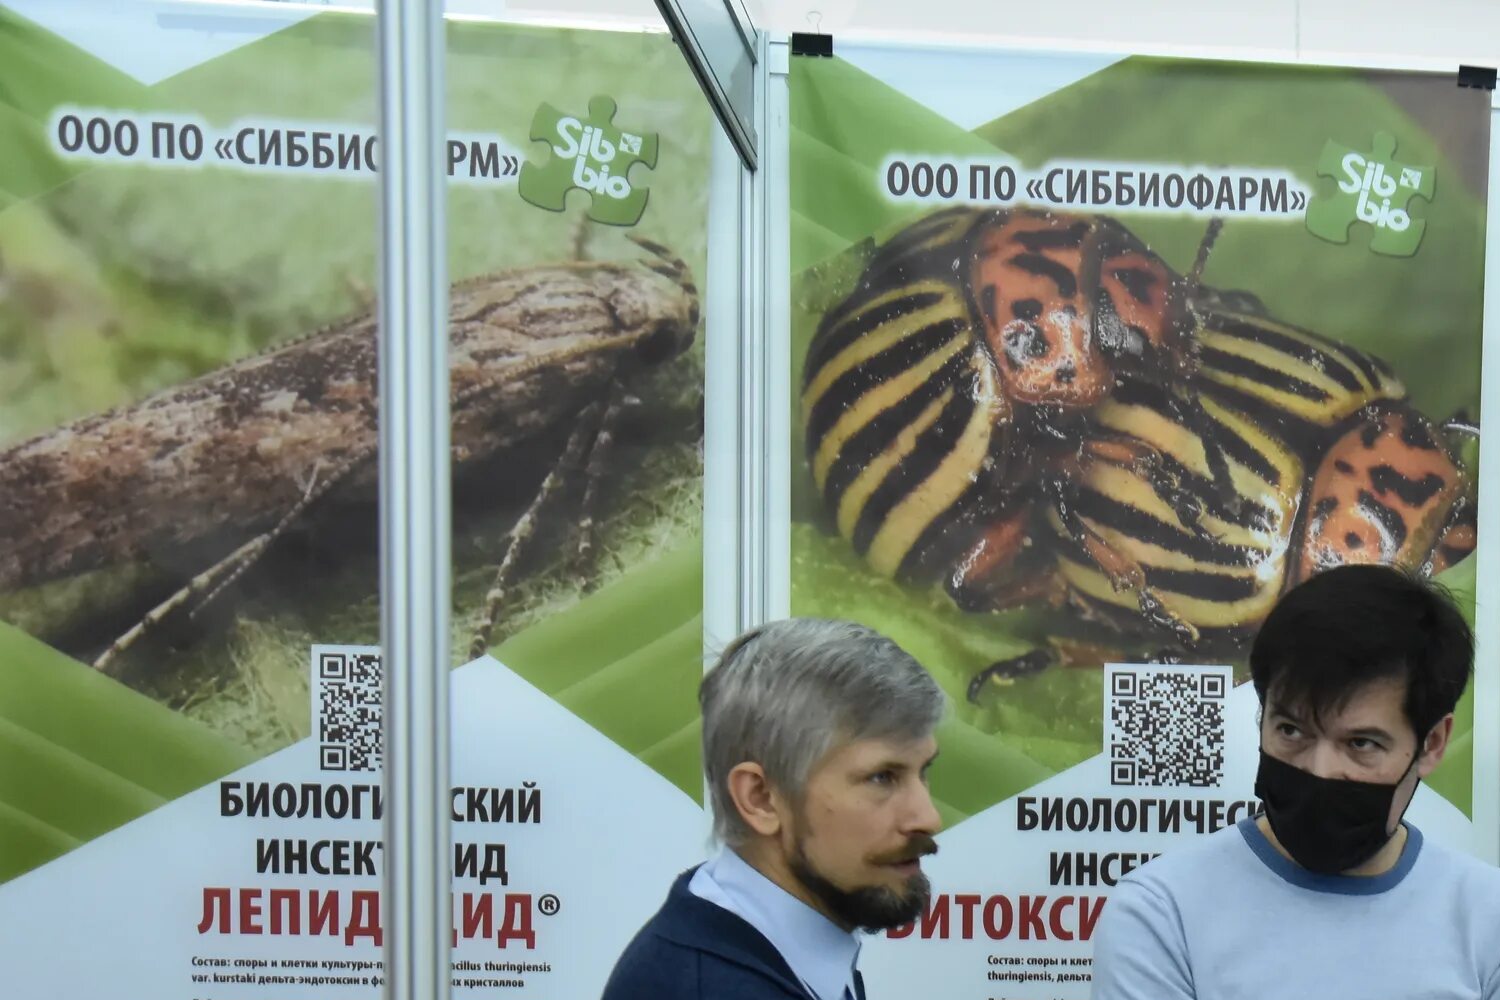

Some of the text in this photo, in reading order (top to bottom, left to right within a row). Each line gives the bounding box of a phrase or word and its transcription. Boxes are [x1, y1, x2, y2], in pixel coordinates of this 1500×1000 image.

[58, 115, 139, 157] ООО
[151, 122, 203, 161] ПО
[554, 117, 616, 163] Sib
[573, 157, 631, 199] bio
[887, 160, 1306, 213] ООО ПО «СИББИОФАРМ»
[1339, 153, 1397, 196] Sib
[1356, 190, 1410, 231] bio
[886, 894, 1108, 940] ИТОКСИ
[191, 956, 318, 970] Состав: споры клетки
[213, 972, 360, 986] kurstaki дельта-эндотоксин
[484, 961, 551, 974] thuringiensis
[987, 955, 1058, 968] Состав: споры
[987, 970, 1054, 983] thuringiensis,
[463, 979, 524, 989] кристаллов
